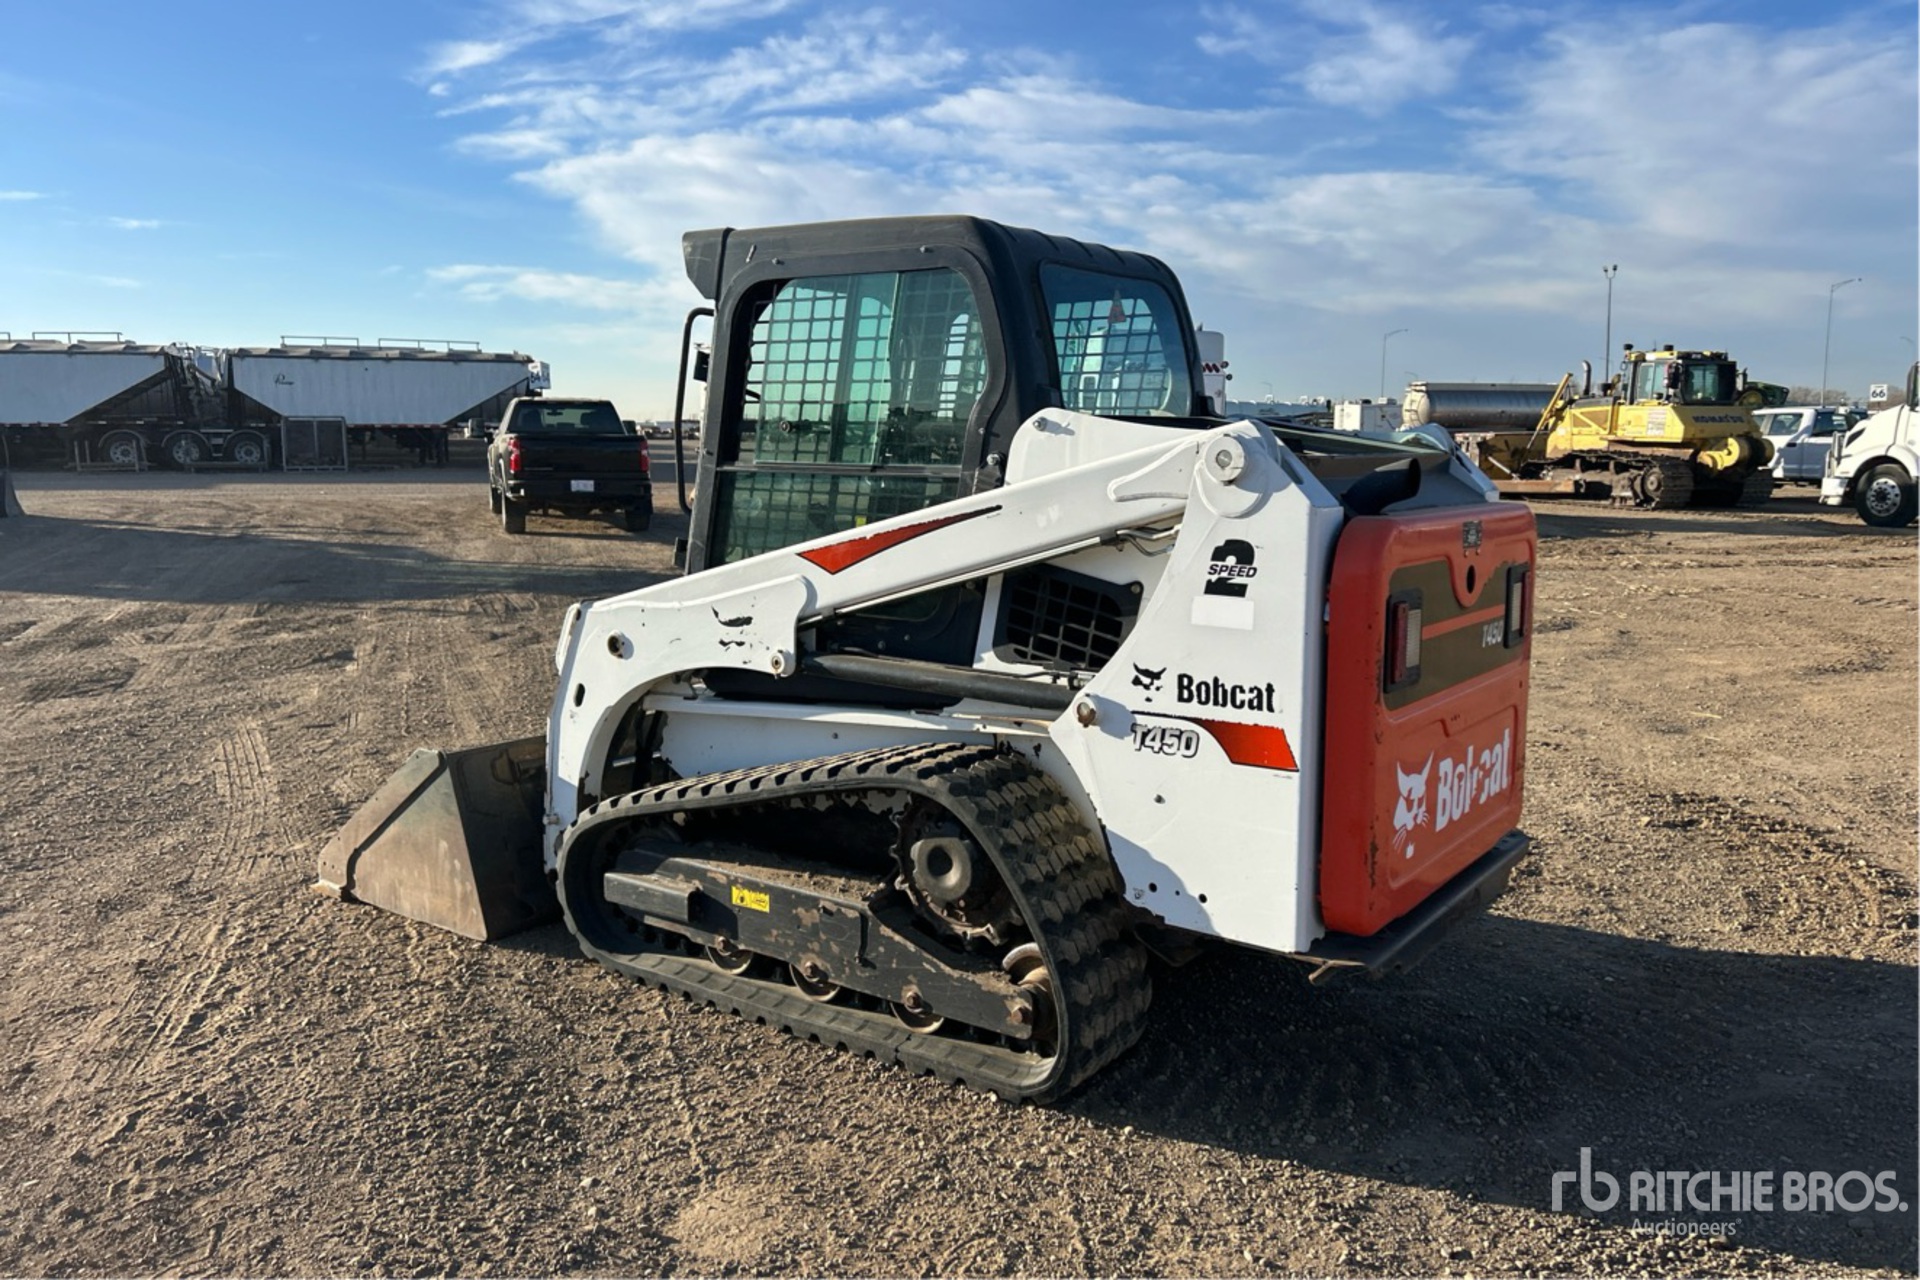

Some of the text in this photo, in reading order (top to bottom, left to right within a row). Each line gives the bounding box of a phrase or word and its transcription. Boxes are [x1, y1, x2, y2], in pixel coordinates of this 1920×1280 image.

[1872, 390, 1886, 398] 66
[1204, 538, 1258, 598] 2 SPEED
[1177, 673, 1275, 713] Bobcat
[1131, 722, 1200, 758] T450
